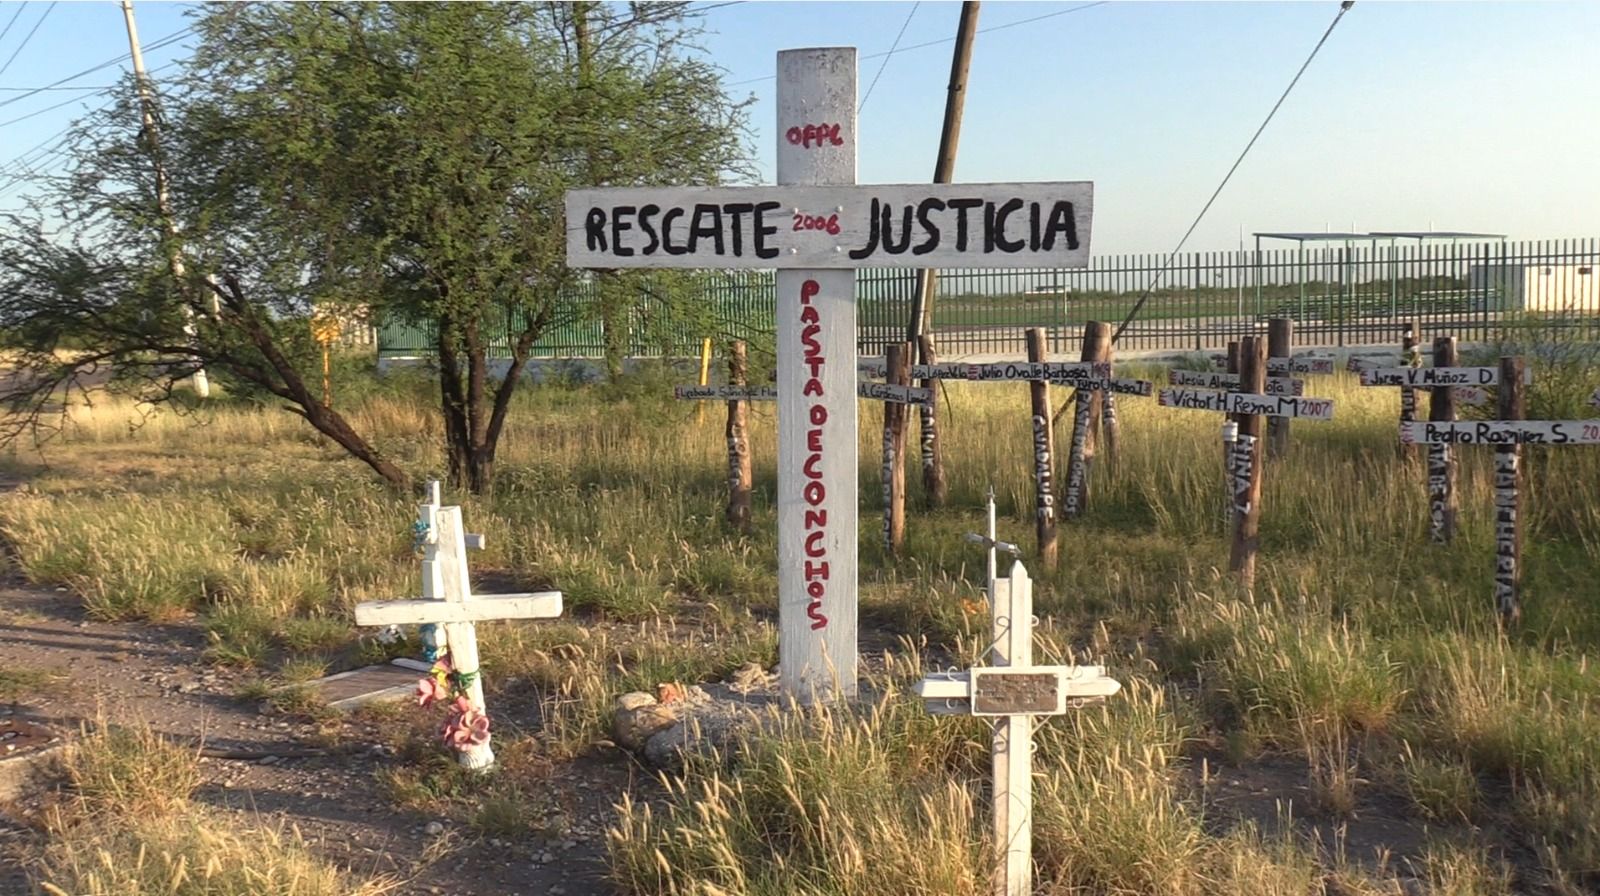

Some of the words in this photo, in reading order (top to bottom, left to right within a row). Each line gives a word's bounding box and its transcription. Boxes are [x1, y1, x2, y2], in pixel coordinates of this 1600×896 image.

[585, 201, 781, 259] RESCATE
[792, 214, 841, 235] 2006
[849, 197, 1079, 260] JUSTICIA
[978, 365, 1003, 380] Julio
[1005, 364, 1042, 379] Ovalle
[1043, 363, 1090, 379] Barbosa
[1423, 369, 1470, 385] Muñoz
[1216, 394, 1231, 412] H.
[1233, 396, 1276, 416] Reyna
[1277, 396, 1298, 417] M
[1300, 400, 1330, 416] 2007
[1425, 423, 1473, 443] Pedro
[1551, 422, 1576, 443] S.
[1032, 414, 1054, 518] GUADALUPE
[1234, 434, 1258, 495] MINA
